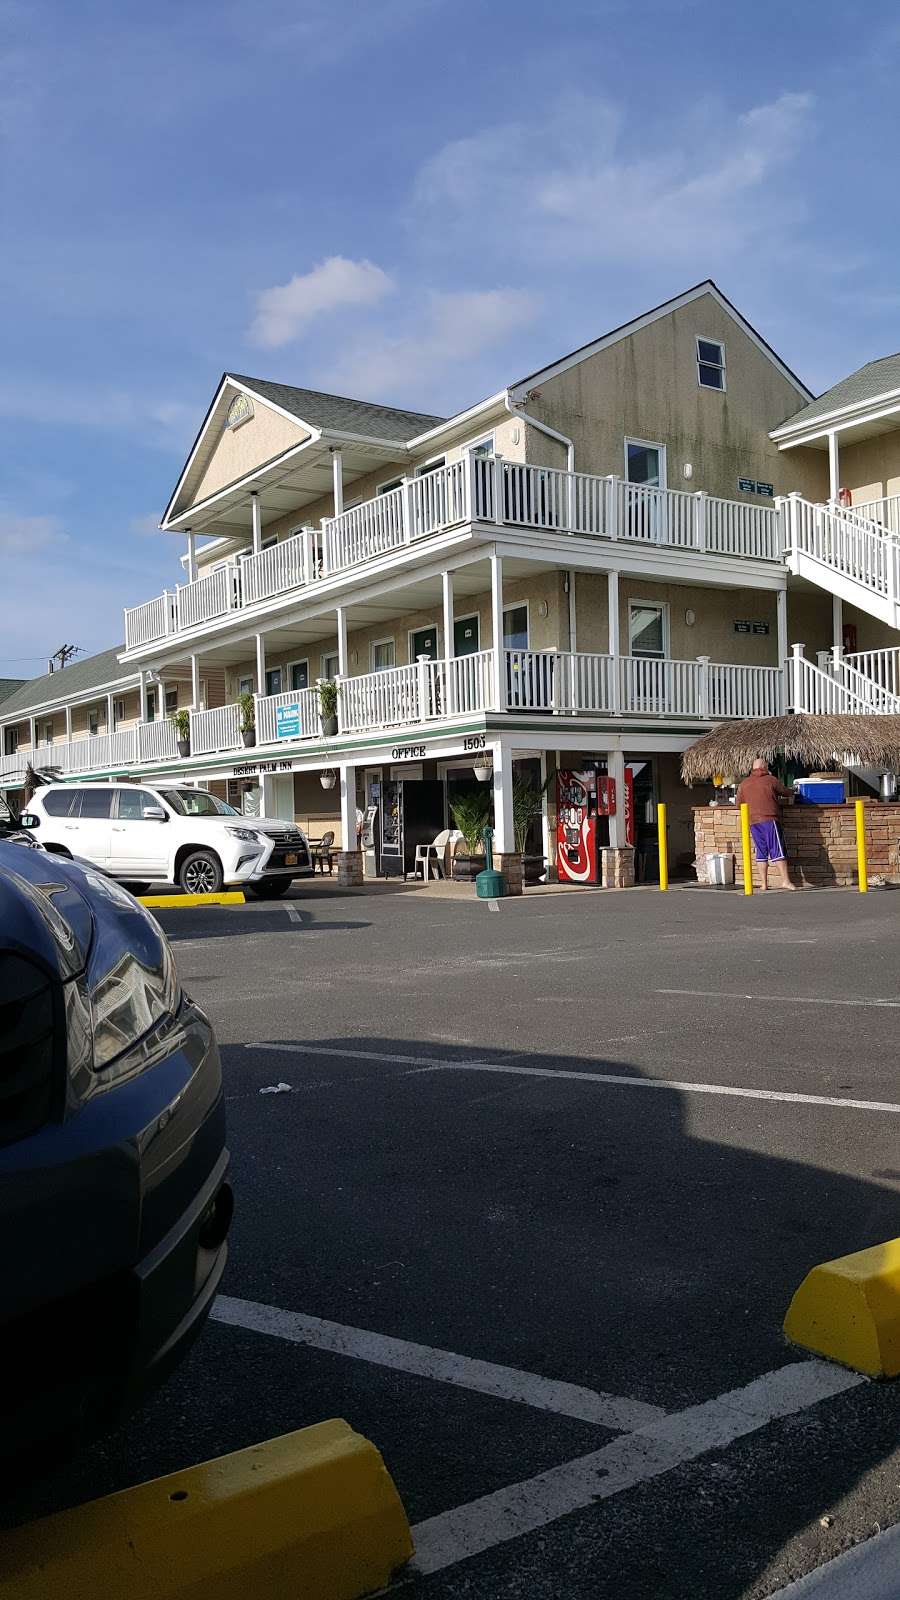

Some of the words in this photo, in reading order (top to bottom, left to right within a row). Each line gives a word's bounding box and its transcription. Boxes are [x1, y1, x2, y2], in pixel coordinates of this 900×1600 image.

[463, 735, 486, 751] 1505
[391, 745, 427, 760] OFFICE
[233, 764, 257, 776] DESERT
[259, 762, 277, 773] PALM
[280, 760, 293, 771] INN
